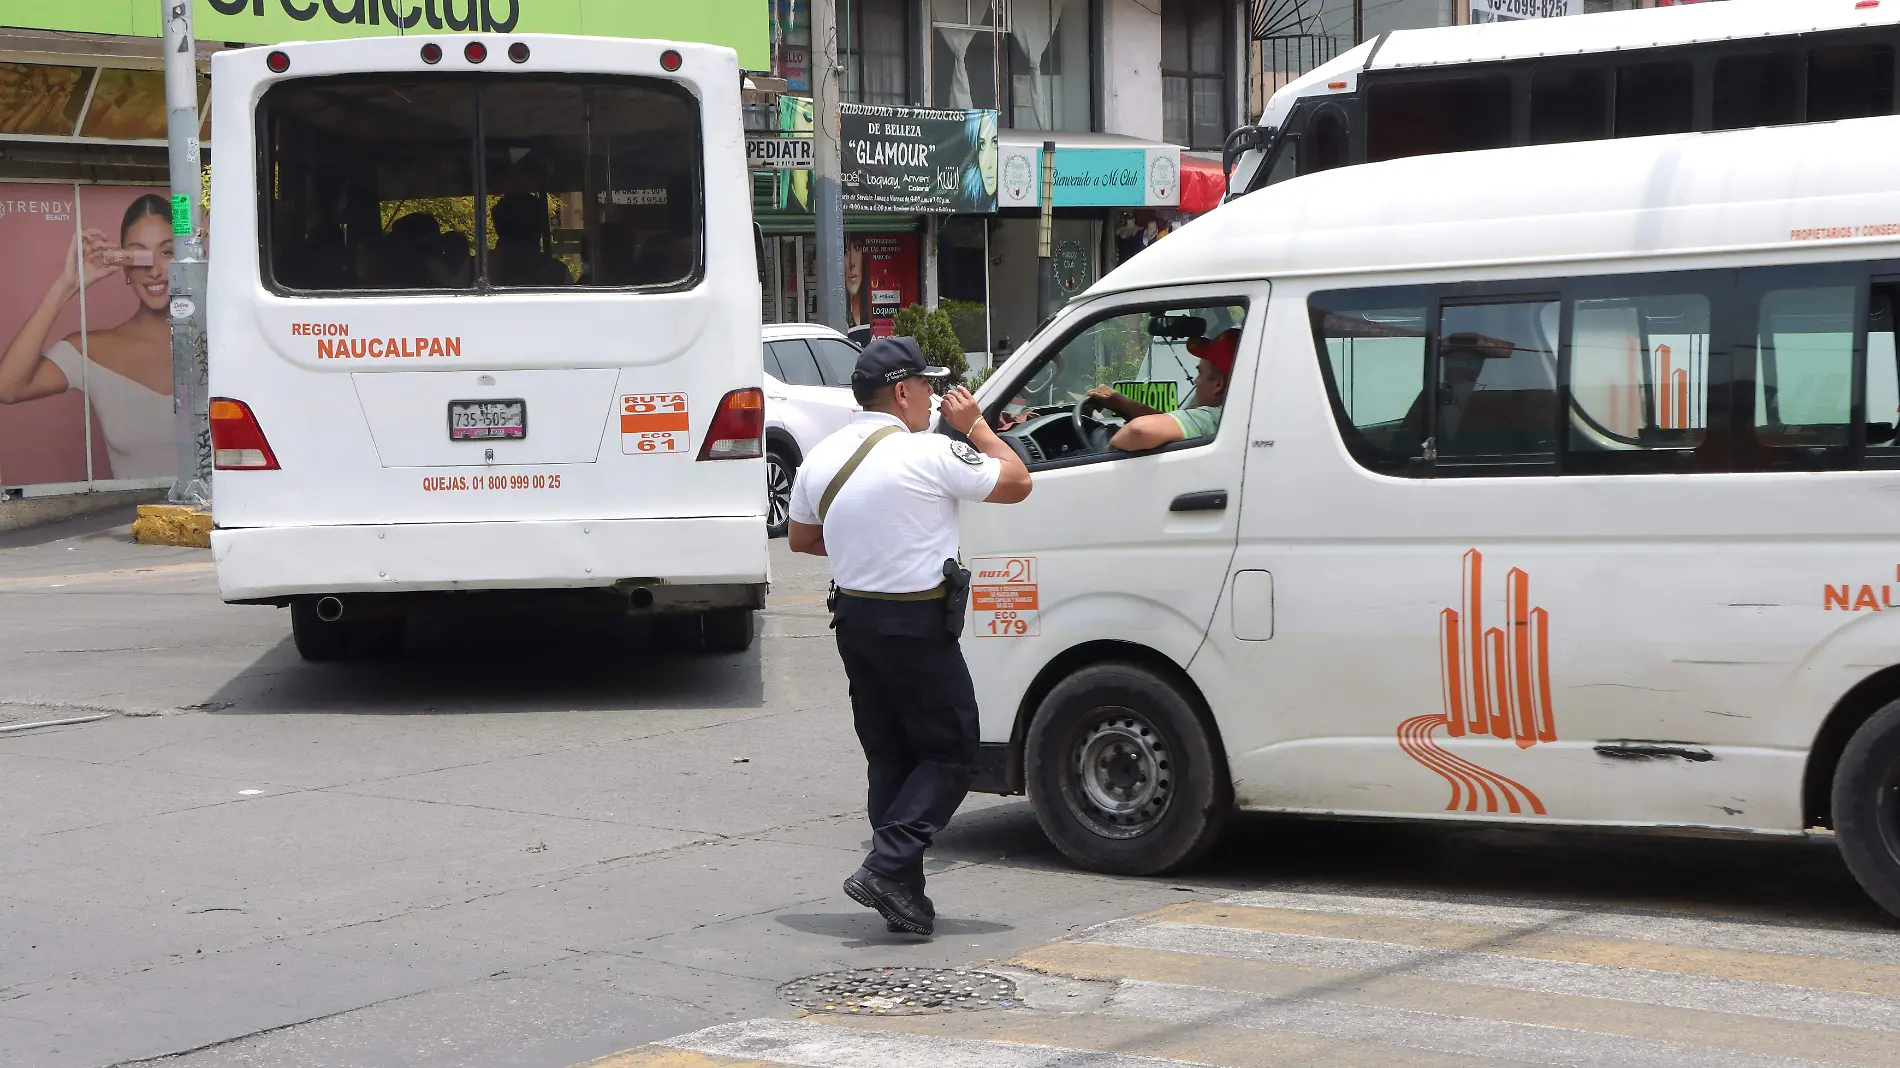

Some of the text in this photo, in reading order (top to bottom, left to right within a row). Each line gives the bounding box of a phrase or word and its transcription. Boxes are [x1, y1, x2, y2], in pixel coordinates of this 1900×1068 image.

[897, 107, 910, 118] DE
[913, 108, 965, 121] PRODUCTOS
[868, 122, 922, 137] DE BELLEZA
[747, 140, 815, 159] PEDIATR
[1052, 168, 1138, 187] Bienvenido a Mi Club
[6, 201, 72, 213] TRENDY
[291, 323, 349, 337] REGION
[317, 336, 461, 359] NAUCALPAN
[624, 394, 686, 404] RUTA
[624, 402, 685, 412] 01
[637, 438, 675, 452] 61
[422, 474, 561, 492] QUEJAS. 01 800 999 00 25
[978, 559, 1031, 582] RUTA 21
[995, 611, 1017, 619] ECO
[988, 619, 1028, 634] 179
